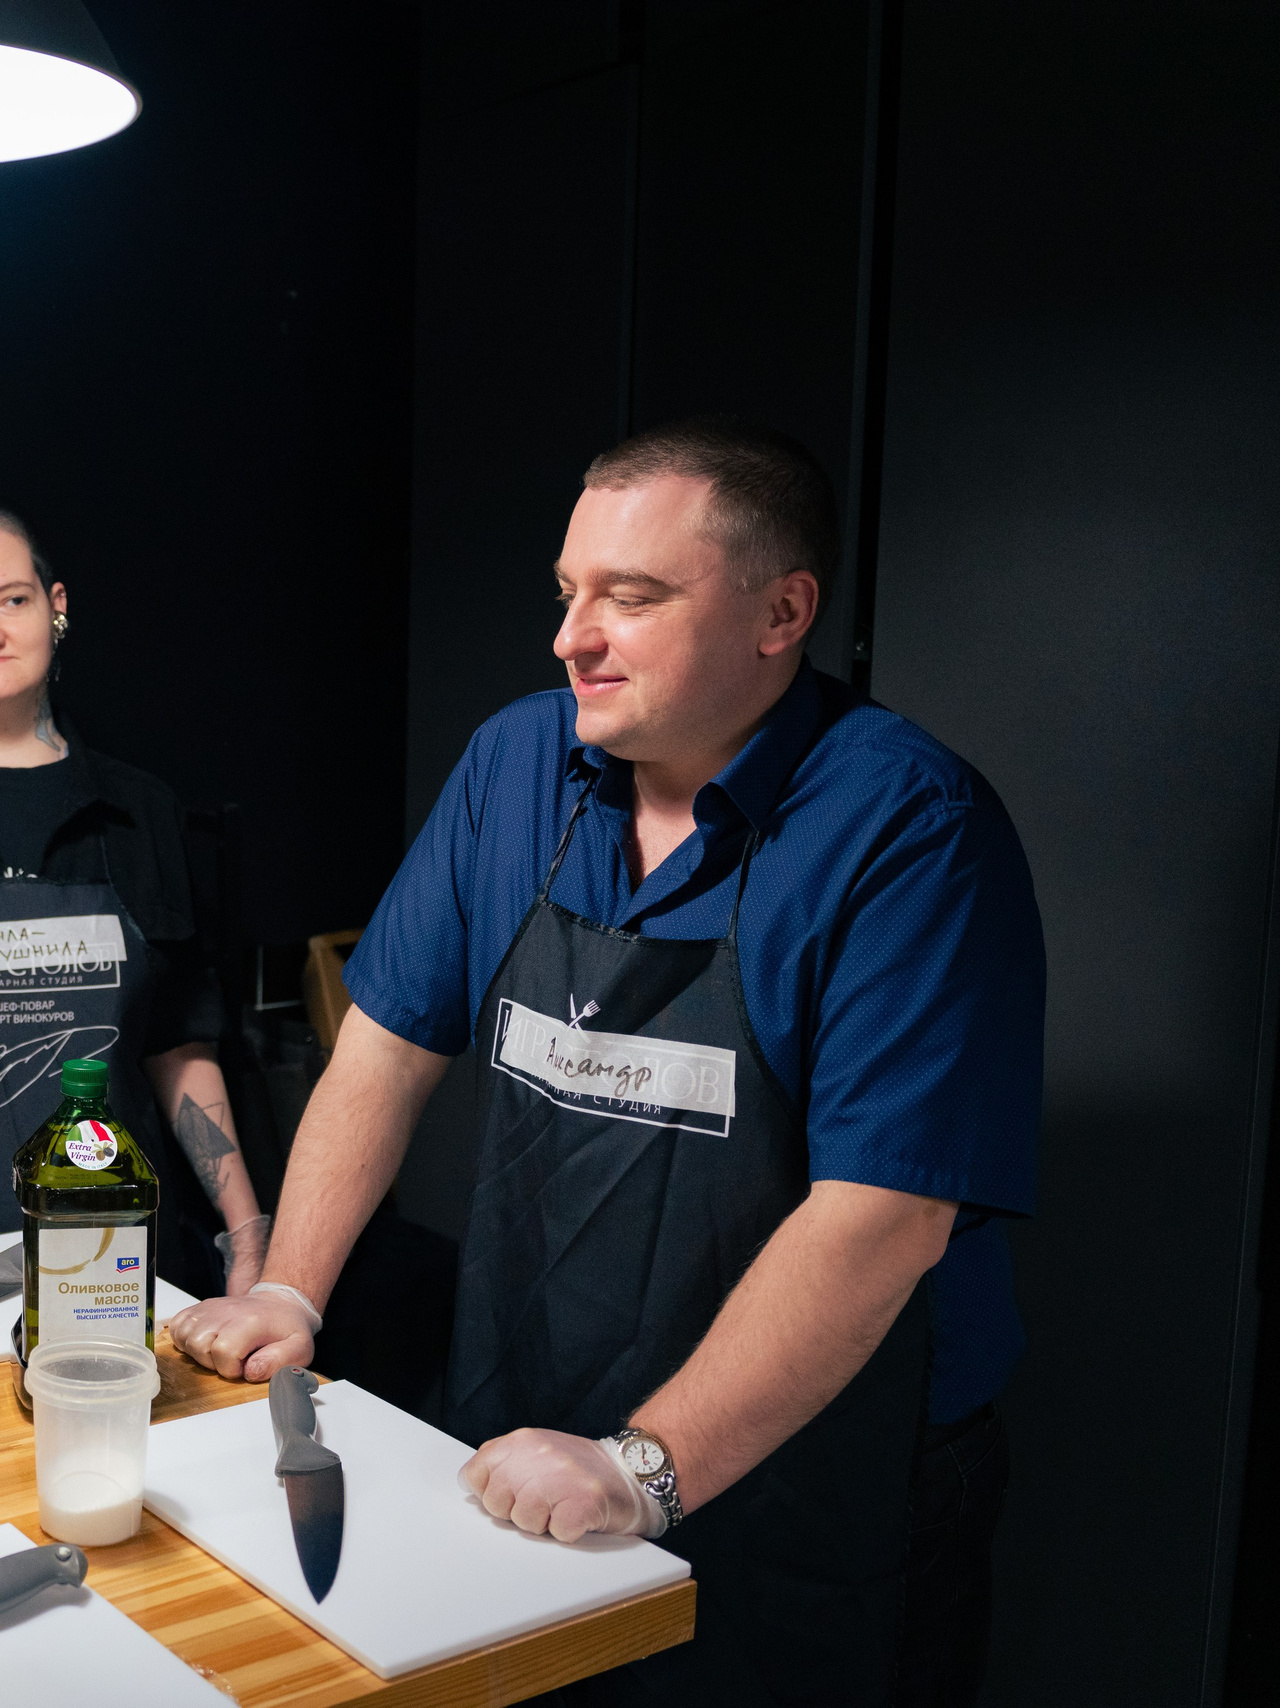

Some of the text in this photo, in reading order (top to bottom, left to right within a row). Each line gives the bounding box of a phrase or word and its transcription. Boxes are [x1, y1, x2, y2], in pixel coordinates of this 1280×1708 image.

[40, 975, 83, 985] СТУДИЯ
[13, 1011, 75, 1024] ВИНОКУРОВ
[68, 1142, 92, 1151] Extra
[70, 1151, 96, 1162] Virgin
[121, 1258, 135, 1266] aro
[58, 1282, 140, 1294] Оливковое
[94, 1294, 140, 1306] масло
[73, 1306, 139, 1314] НЕРАФИНИРОВАННОЕ
